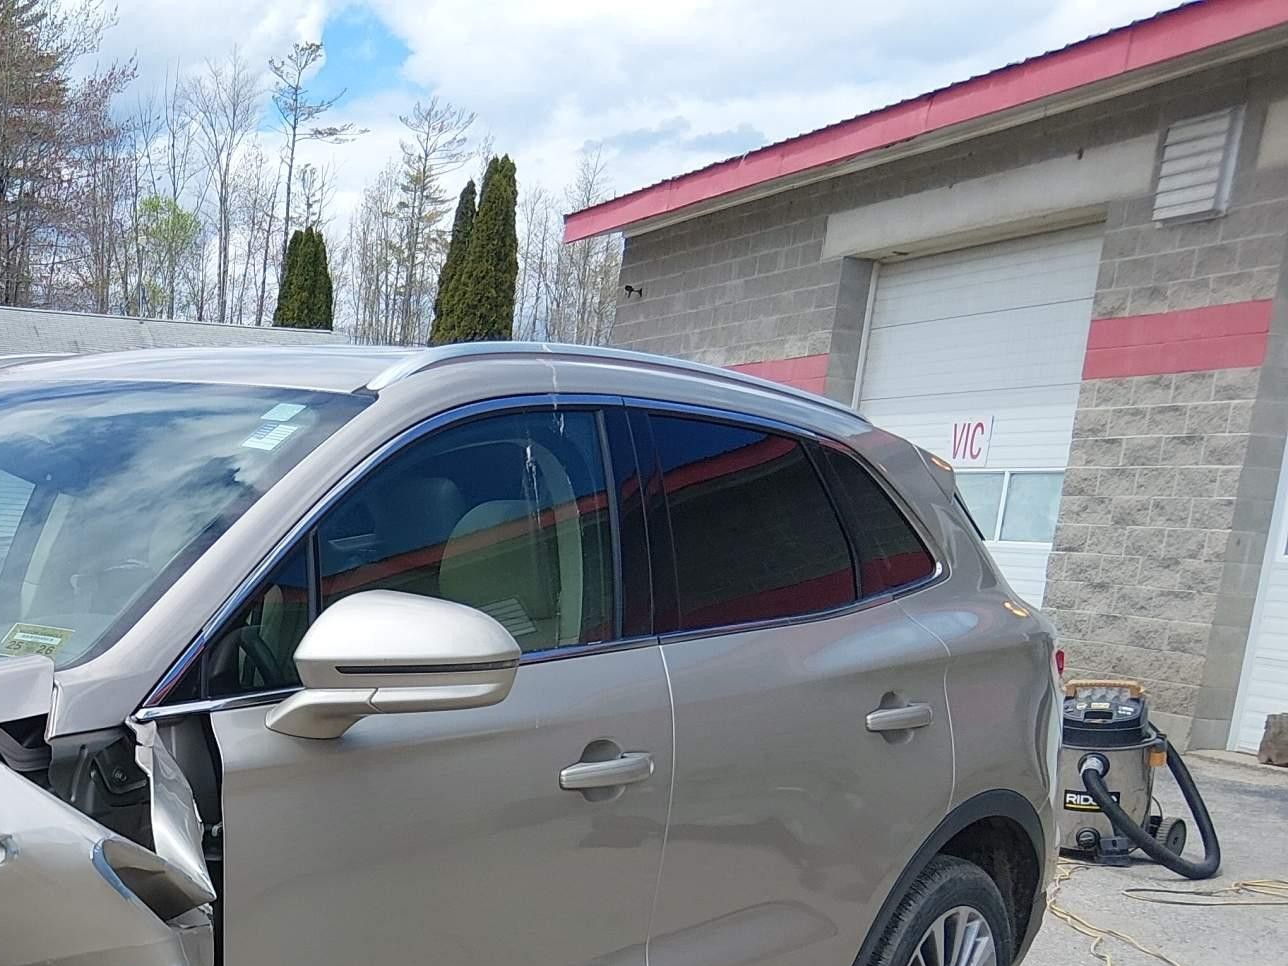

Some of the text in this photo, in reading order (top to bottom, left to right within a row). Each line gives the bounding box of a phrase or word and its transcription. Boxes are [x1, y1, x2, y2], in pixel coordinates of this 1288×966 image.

[952, 421, 985, 460] VIC
[6, 640, 56, 655] 25 26
